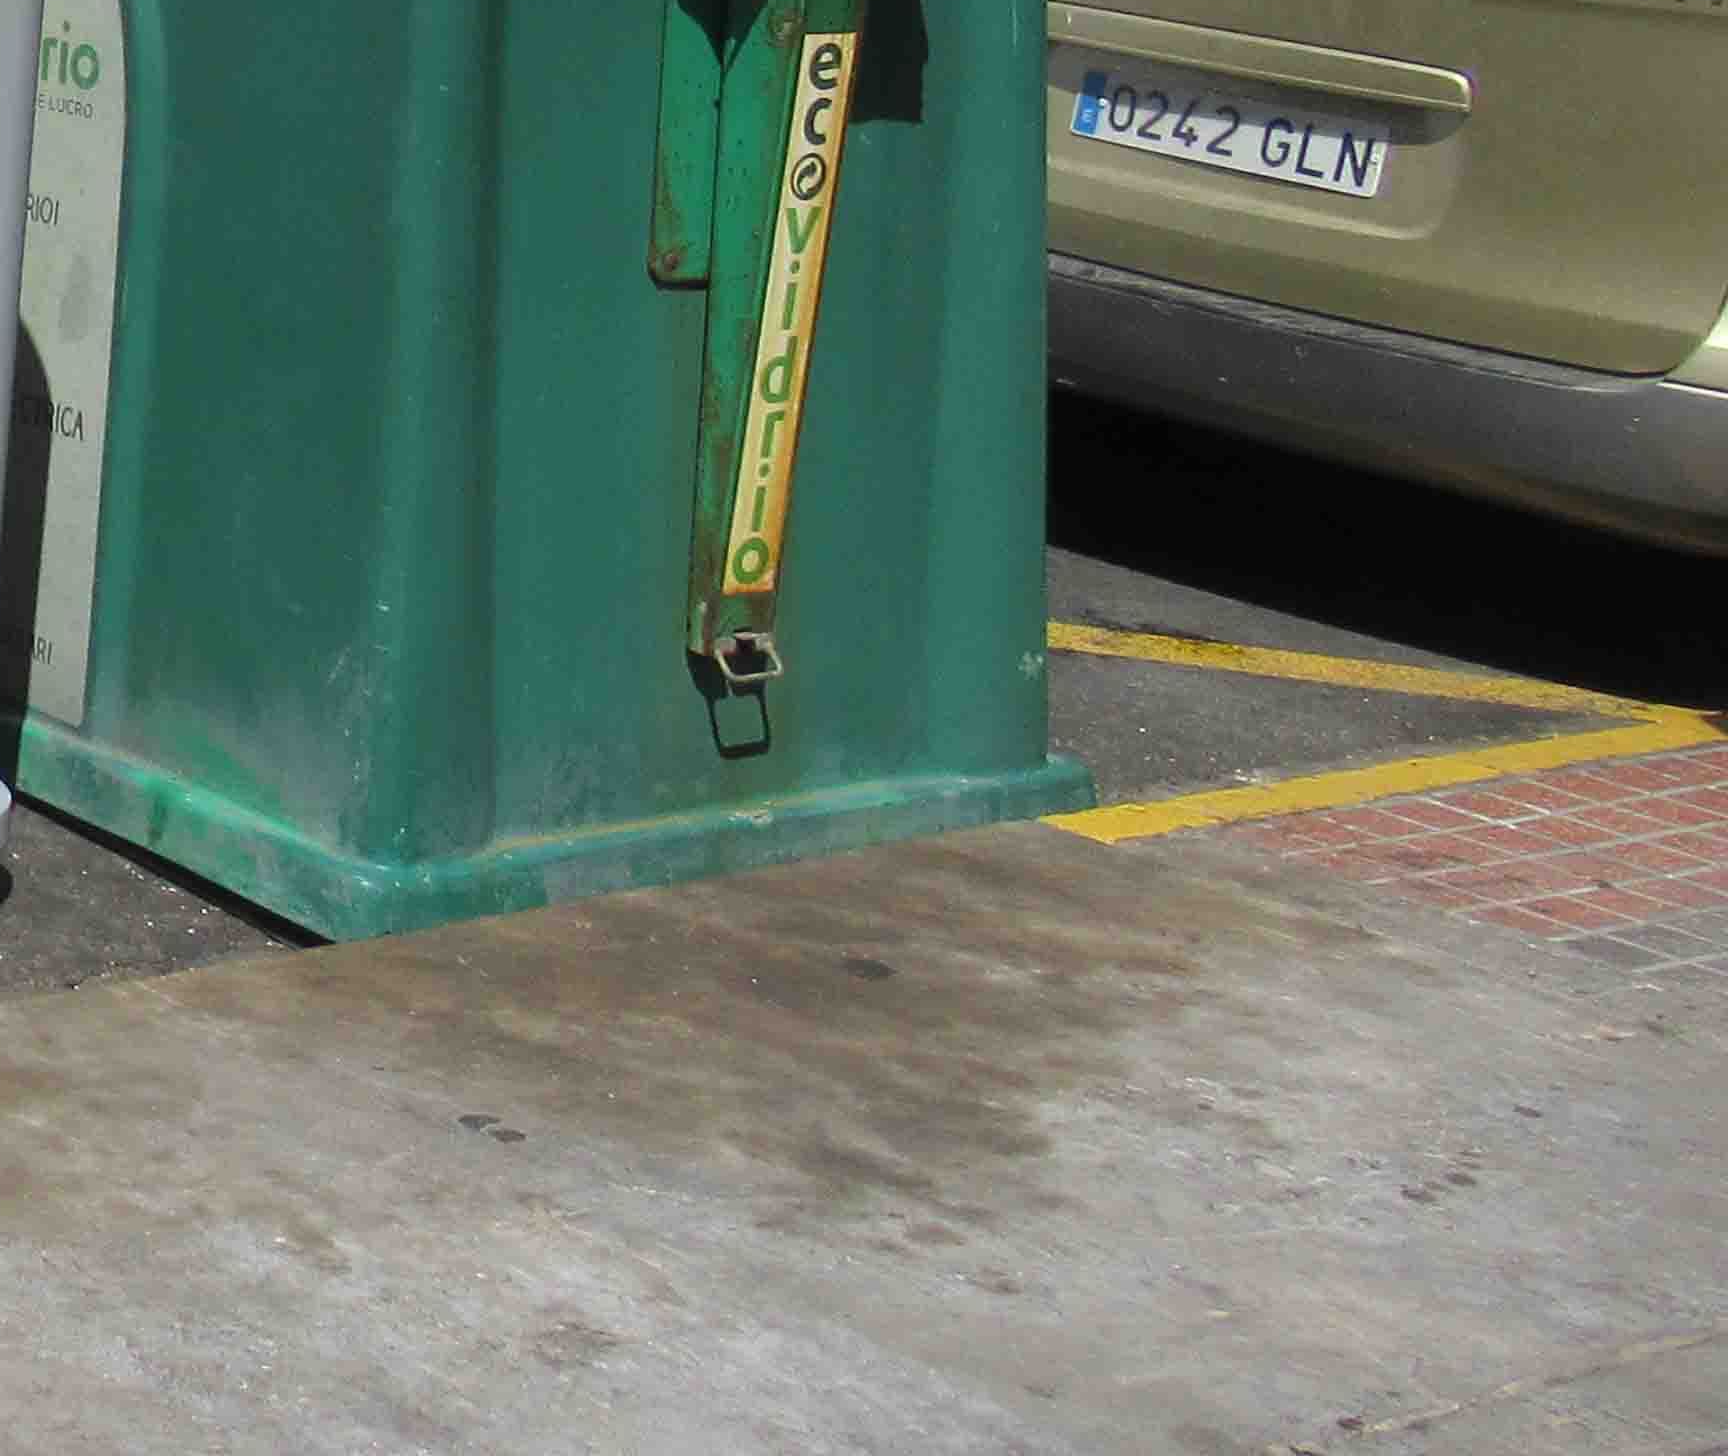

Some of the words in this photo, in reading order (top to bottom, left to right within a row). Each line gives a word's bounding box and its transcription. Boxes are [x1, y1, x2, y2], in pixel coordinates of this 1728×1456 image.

[40, 20, 100, 90] rio
[48, 98, 94, 119] LUCRO
[1108, 84, 1242, 158] 0242
[1259, 116, 1376, 188] GLN
